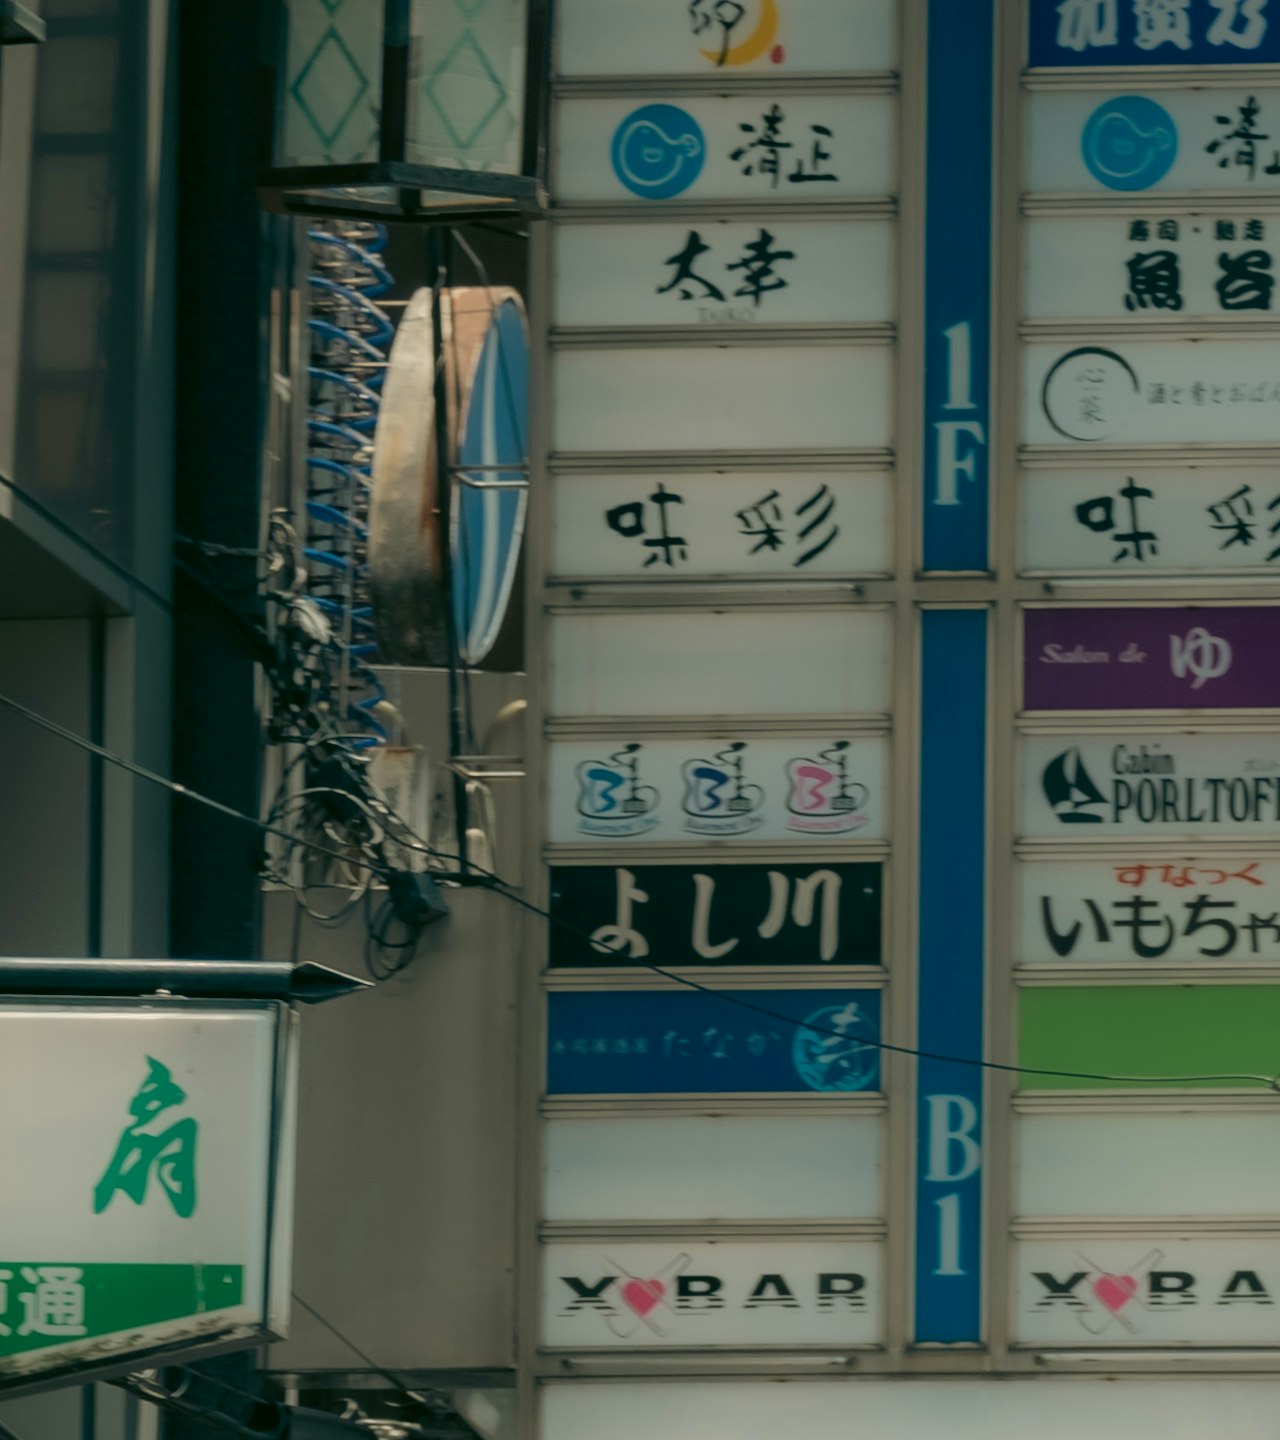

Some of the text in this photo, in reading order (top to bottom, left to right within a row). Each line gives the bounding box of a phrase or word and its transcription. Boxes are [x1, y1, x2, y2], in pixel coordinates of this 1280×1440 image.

[932, 321, 985, 505] 1F
[1112, 743, 1175, 775] Cabin
[1114, 862, 1265, 888] すなっく
[925, 1094, 982, 1277] B1
[676, 1271, 868, 1316] BAR
